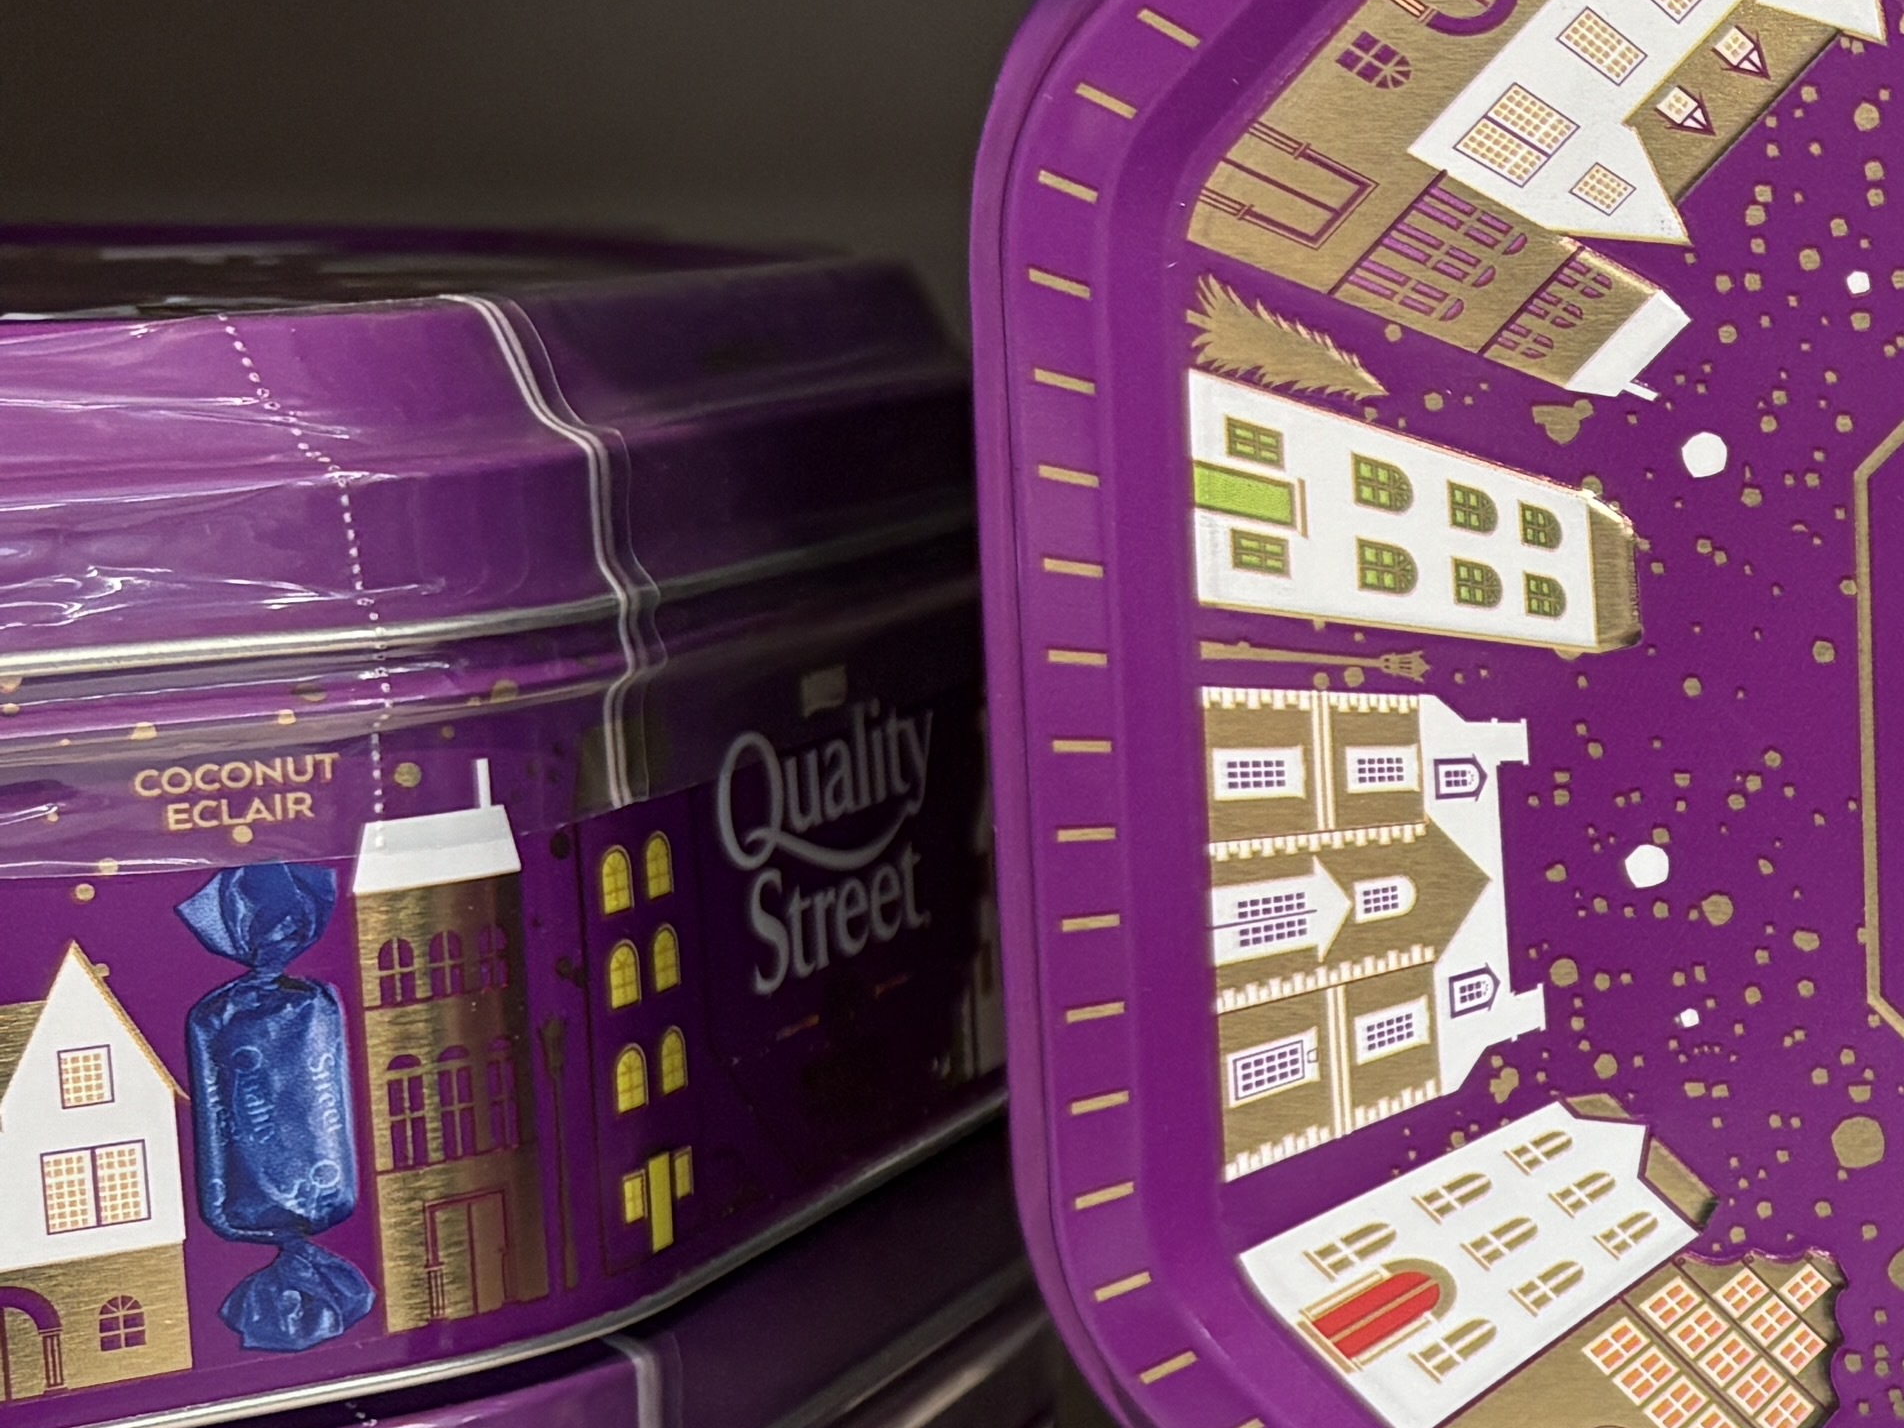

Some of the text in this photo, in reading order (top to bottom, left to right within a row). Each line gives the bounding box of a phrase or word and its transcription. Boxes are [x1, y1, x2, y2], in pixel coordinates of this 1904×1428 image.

[134, 752, 341, 797] COCONUT
[167, 792, 315, 831] ECLAIR
[717, 697, 933, 871] Quality
[751, 841, 923, 996] Street
